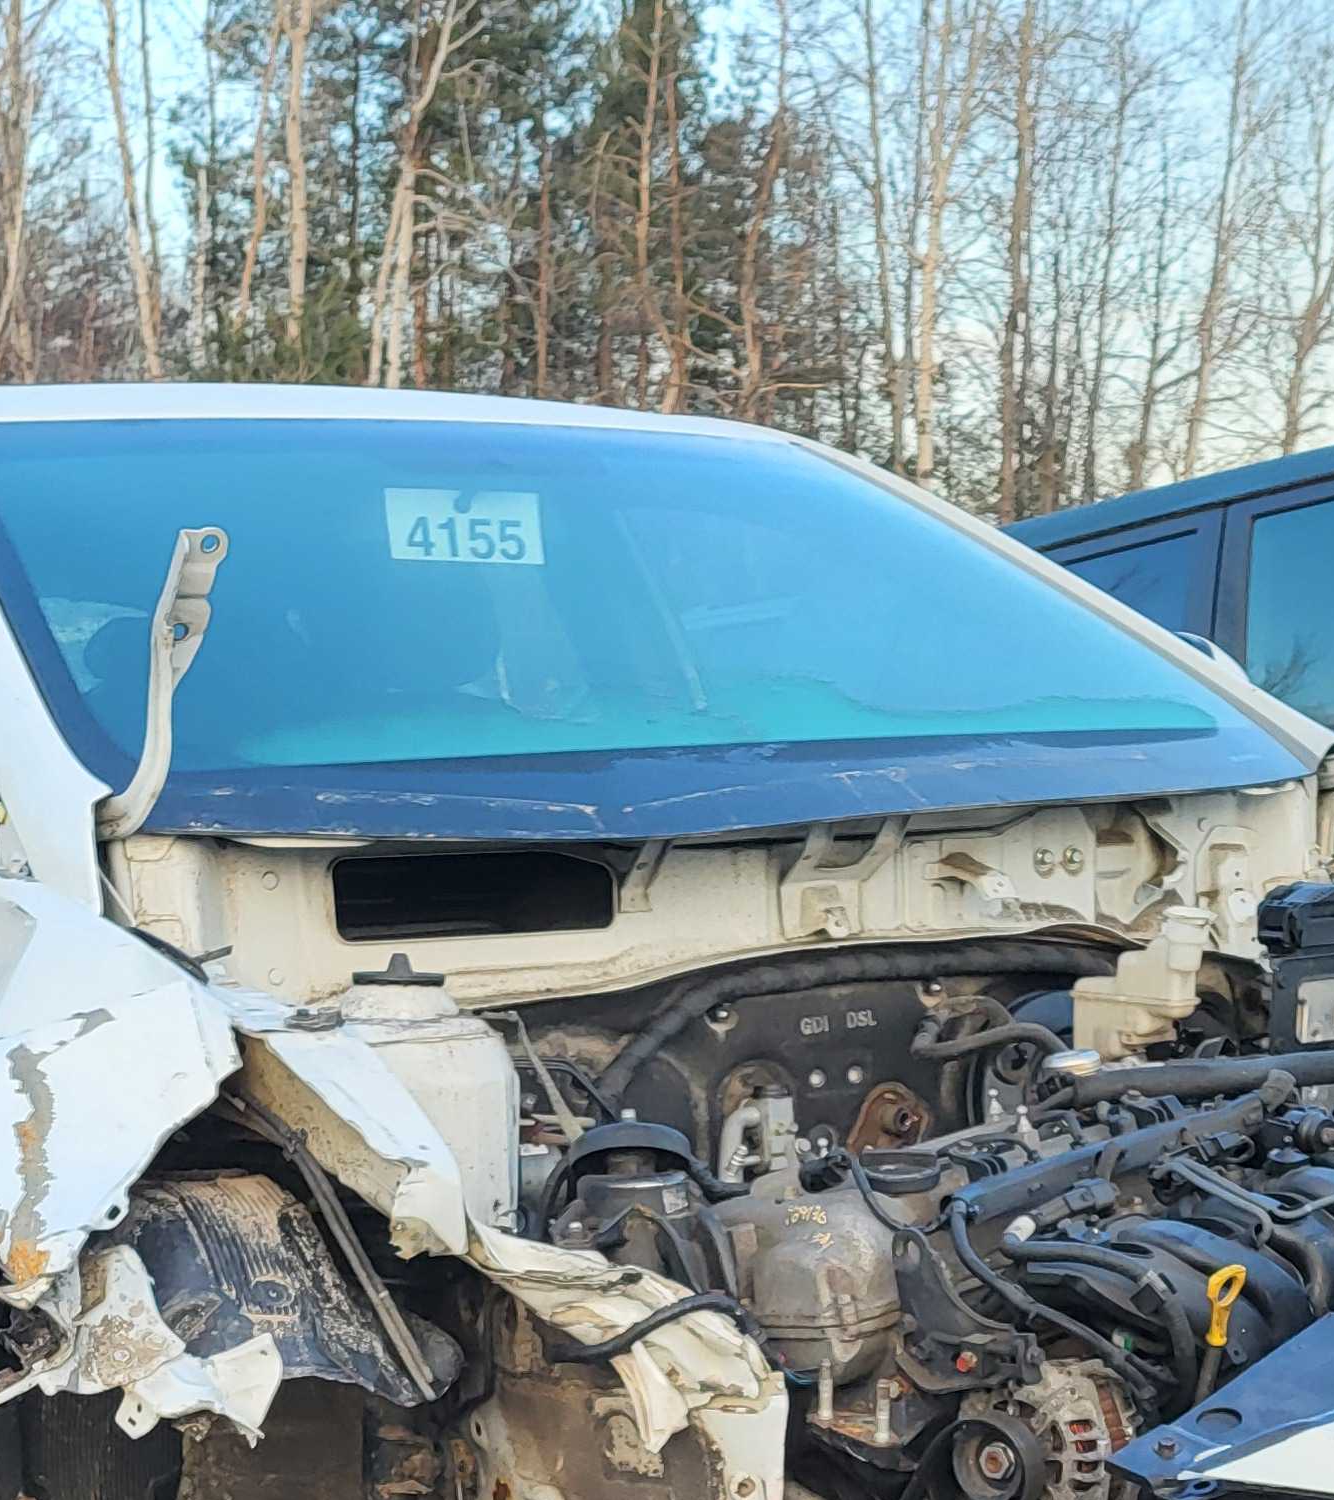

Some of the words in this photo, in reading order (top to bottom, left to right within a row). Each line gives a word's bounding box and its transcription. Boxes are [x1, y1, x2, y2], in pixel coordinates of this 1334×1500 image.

[407, 516, 526, 560] 4155
[800, 1015, 829, 1035] GDI
[847, 1010, 877, 1029] DSL
